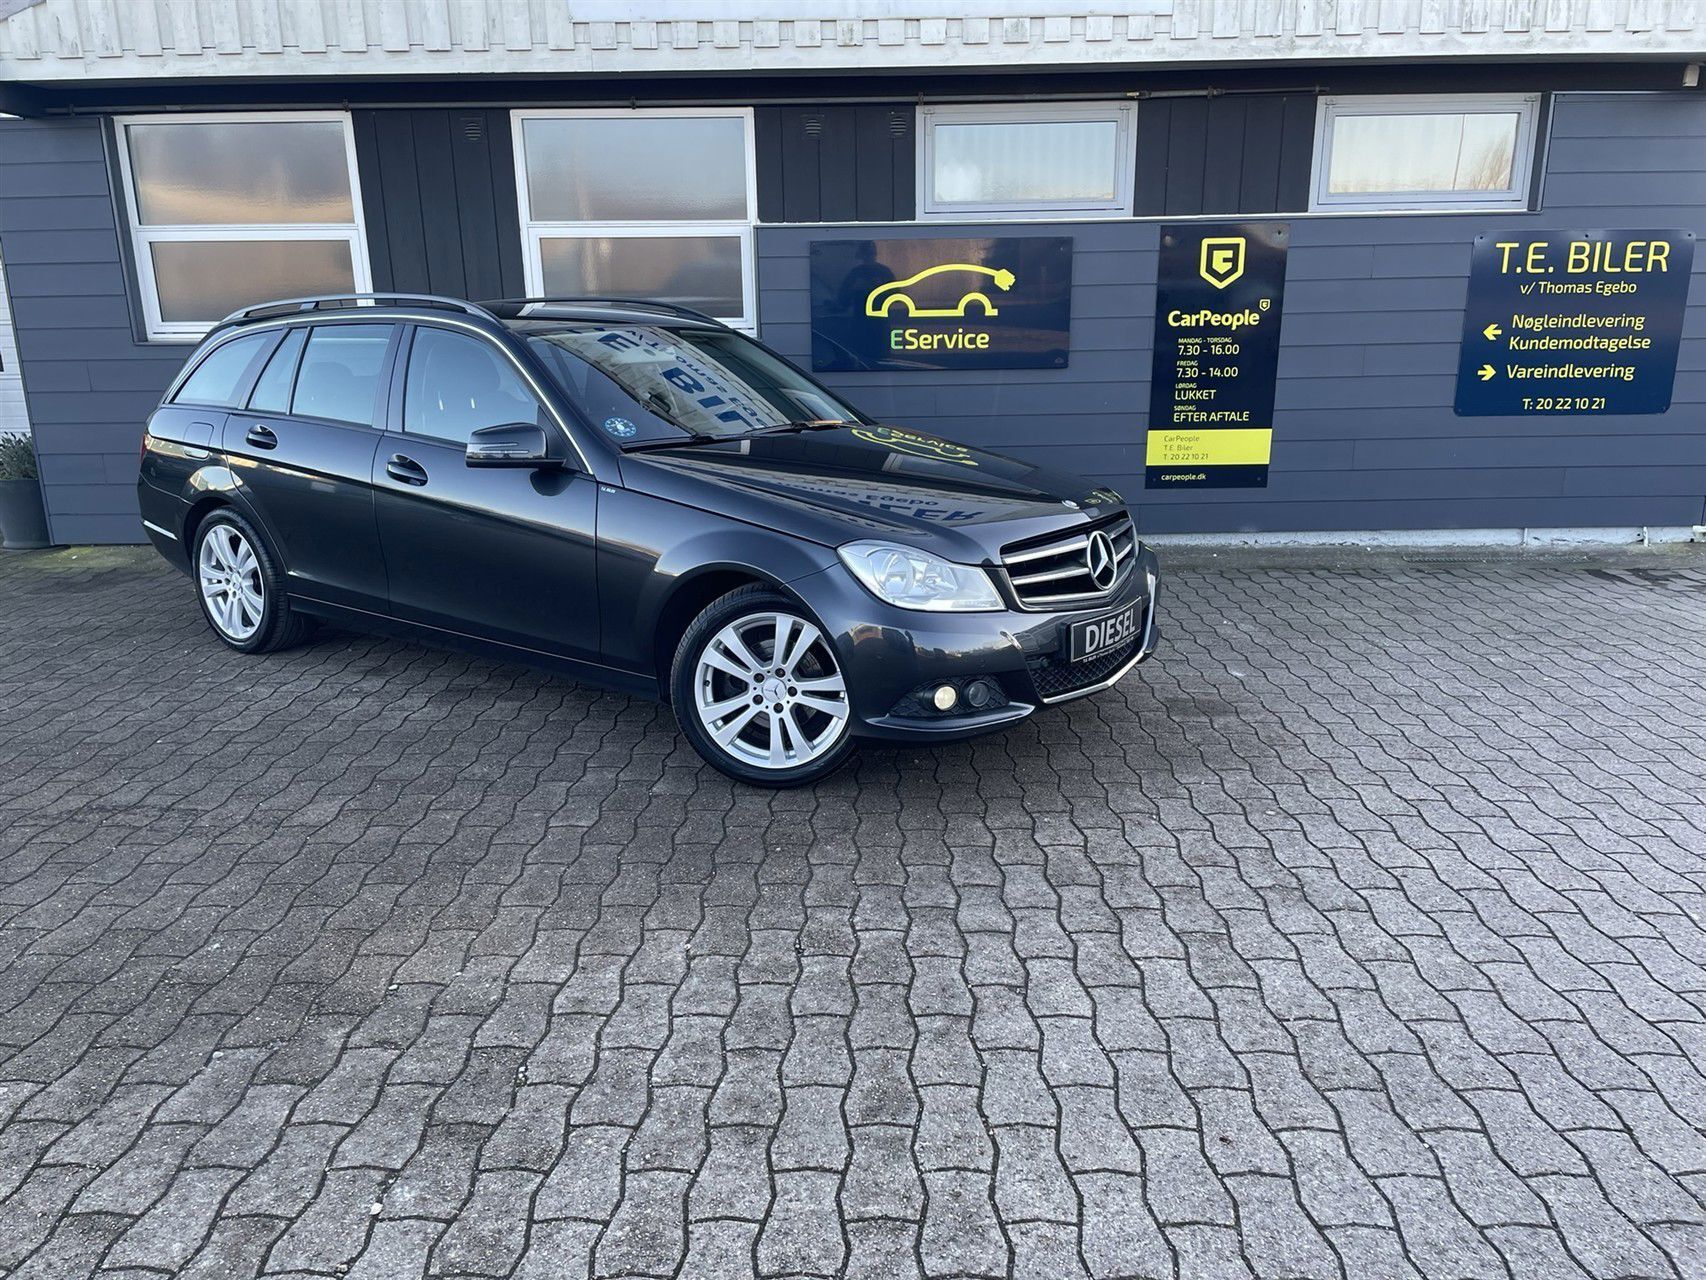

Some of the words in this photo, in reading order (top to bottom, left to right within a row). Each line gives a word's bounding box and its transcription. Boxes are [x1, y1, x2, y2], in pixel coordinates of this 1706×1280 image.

[1495, 242, 1554, 273] T.E.
[1567, 241, 1671, 273] BILER
[1520, 281, 1536, 295] v/
[1539, 281, 1592, 294] Thomas
[1596, 281, 1638, 296] Egebo
[1167, 309, 1260, 331] CarPeople
[1512, 313, 1646, 332] Nøgleindlevering
[890, 328, 990, 350] EService
[1509, 335, 1652, 353] Kundemodtagelse
[1178, 345, 1200, 356] 7.30
[1211, 344, 1240, 355] 16.00
[1177, 368, 1199, 378] 7.30
[1209, 367, 1239, 377] 14.00
[1506, 363, 1635, 381] Vareindlevering
[1175, 390, 1217, 400] LUKKET
[1522, 399, 1533, 410] T:
[1536, 399, 1553, 410] 20
[1555, 398, 1572, 410] 22
[1575, 398, 1588, 410] 10
[1591, 398, 1606, 410] 21
[1174, 412, 1207, 422] EFTER
[1209, 411, 1249, 422] AFTALE
[1164, 435, 1200, 443] CarPeople
[1161, 473, 1206, 481] carpeople.dk
[1085, 608, 1136, 654] DIESEL
